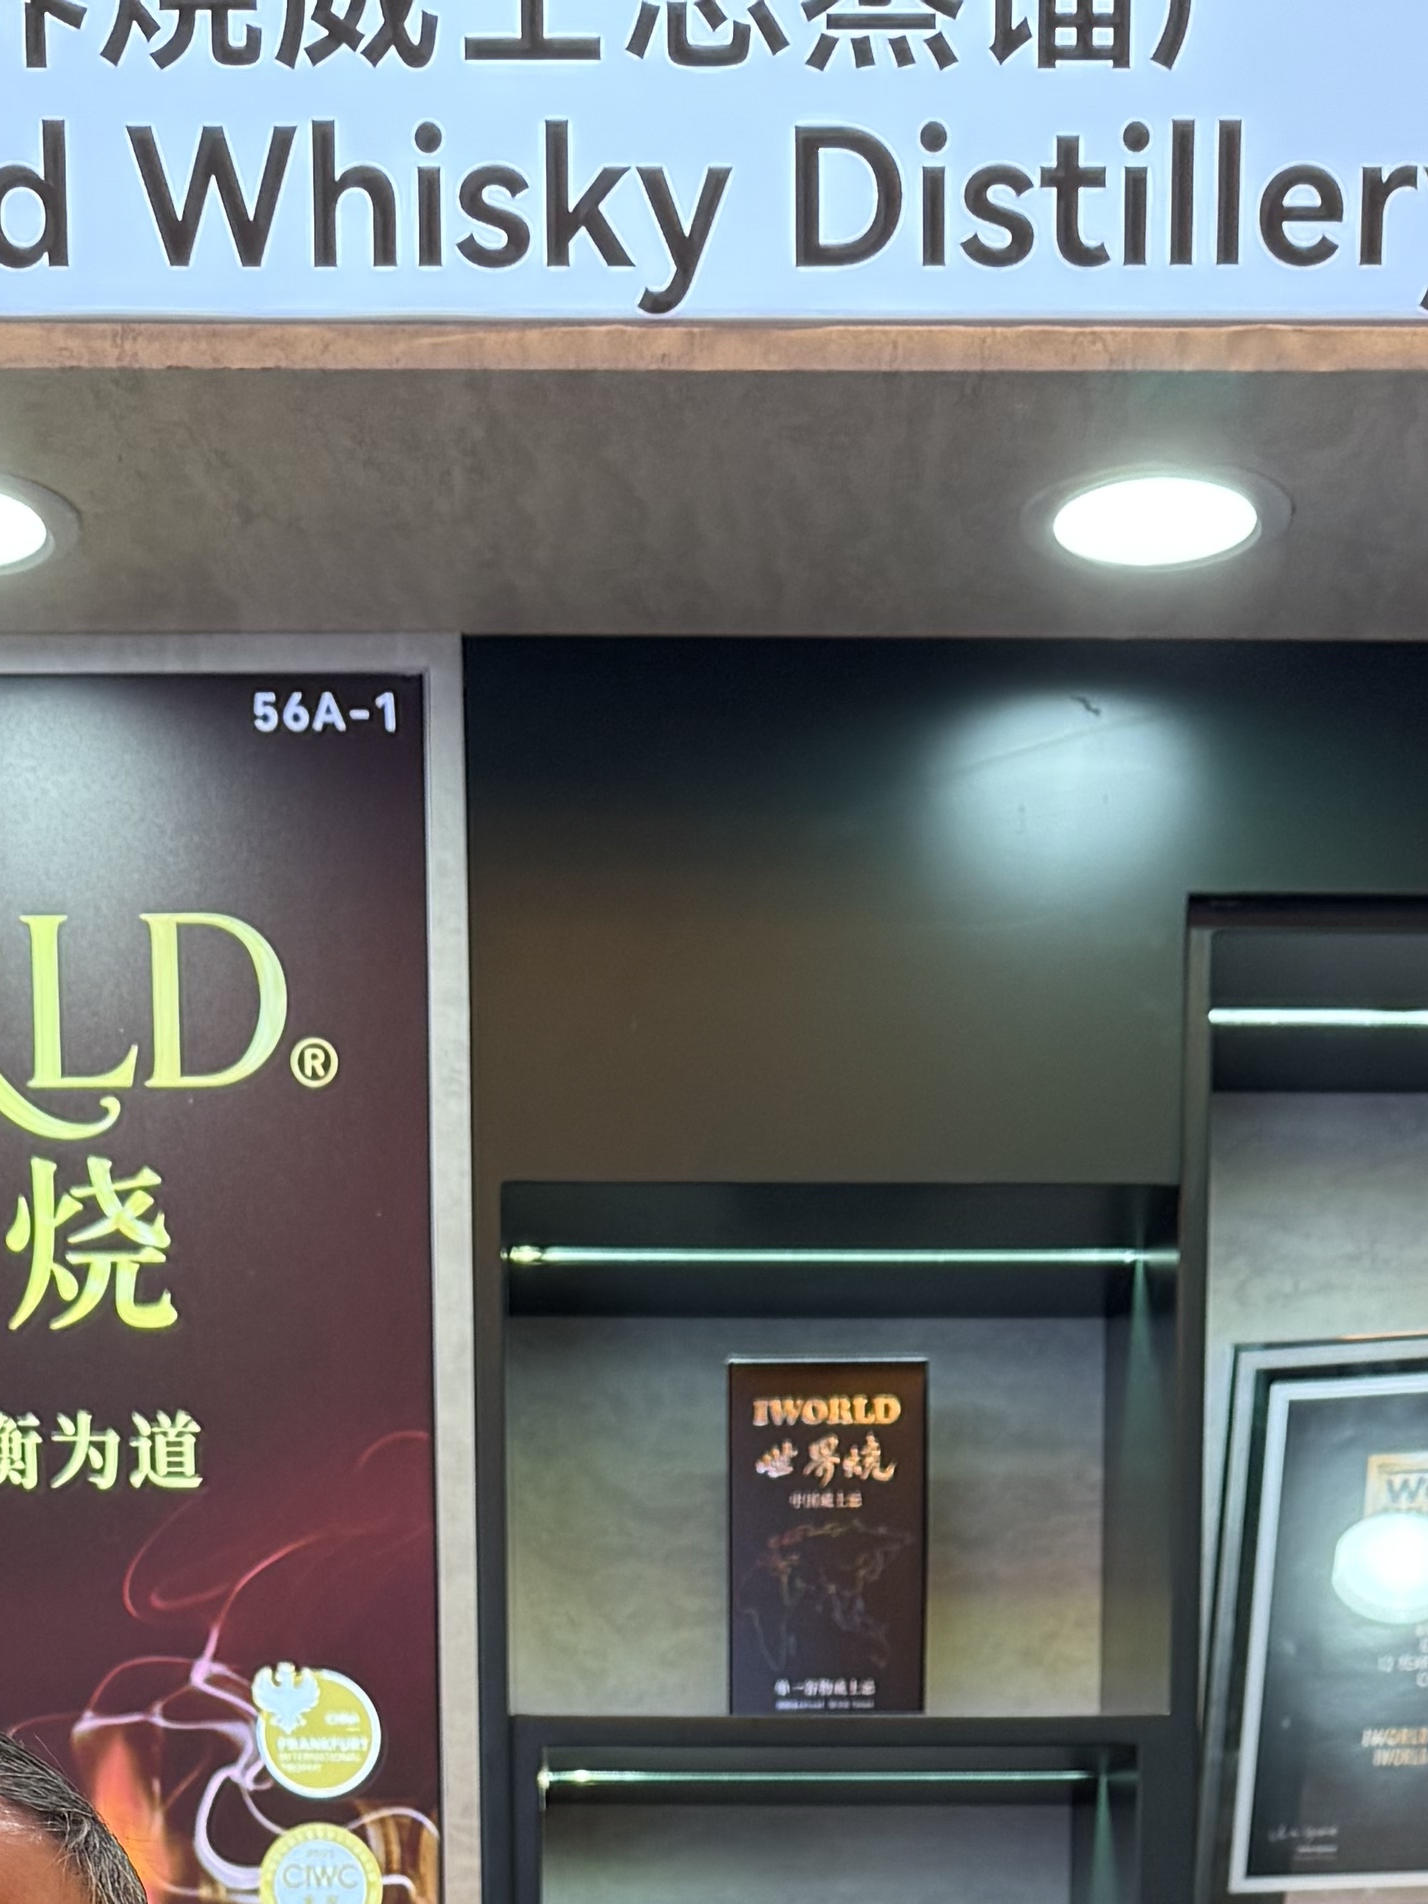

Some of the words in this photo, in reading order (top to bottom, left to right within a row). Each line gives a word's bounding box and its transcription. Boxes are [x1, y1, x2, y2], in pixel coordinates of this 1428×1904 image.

[126, 119, 733, 315] Whisky
[252, 690, 398, 735] 56A-1
[752, 1394, 902, 1427] IWORLD
[283, 1863, 359, 1890] CIWC
